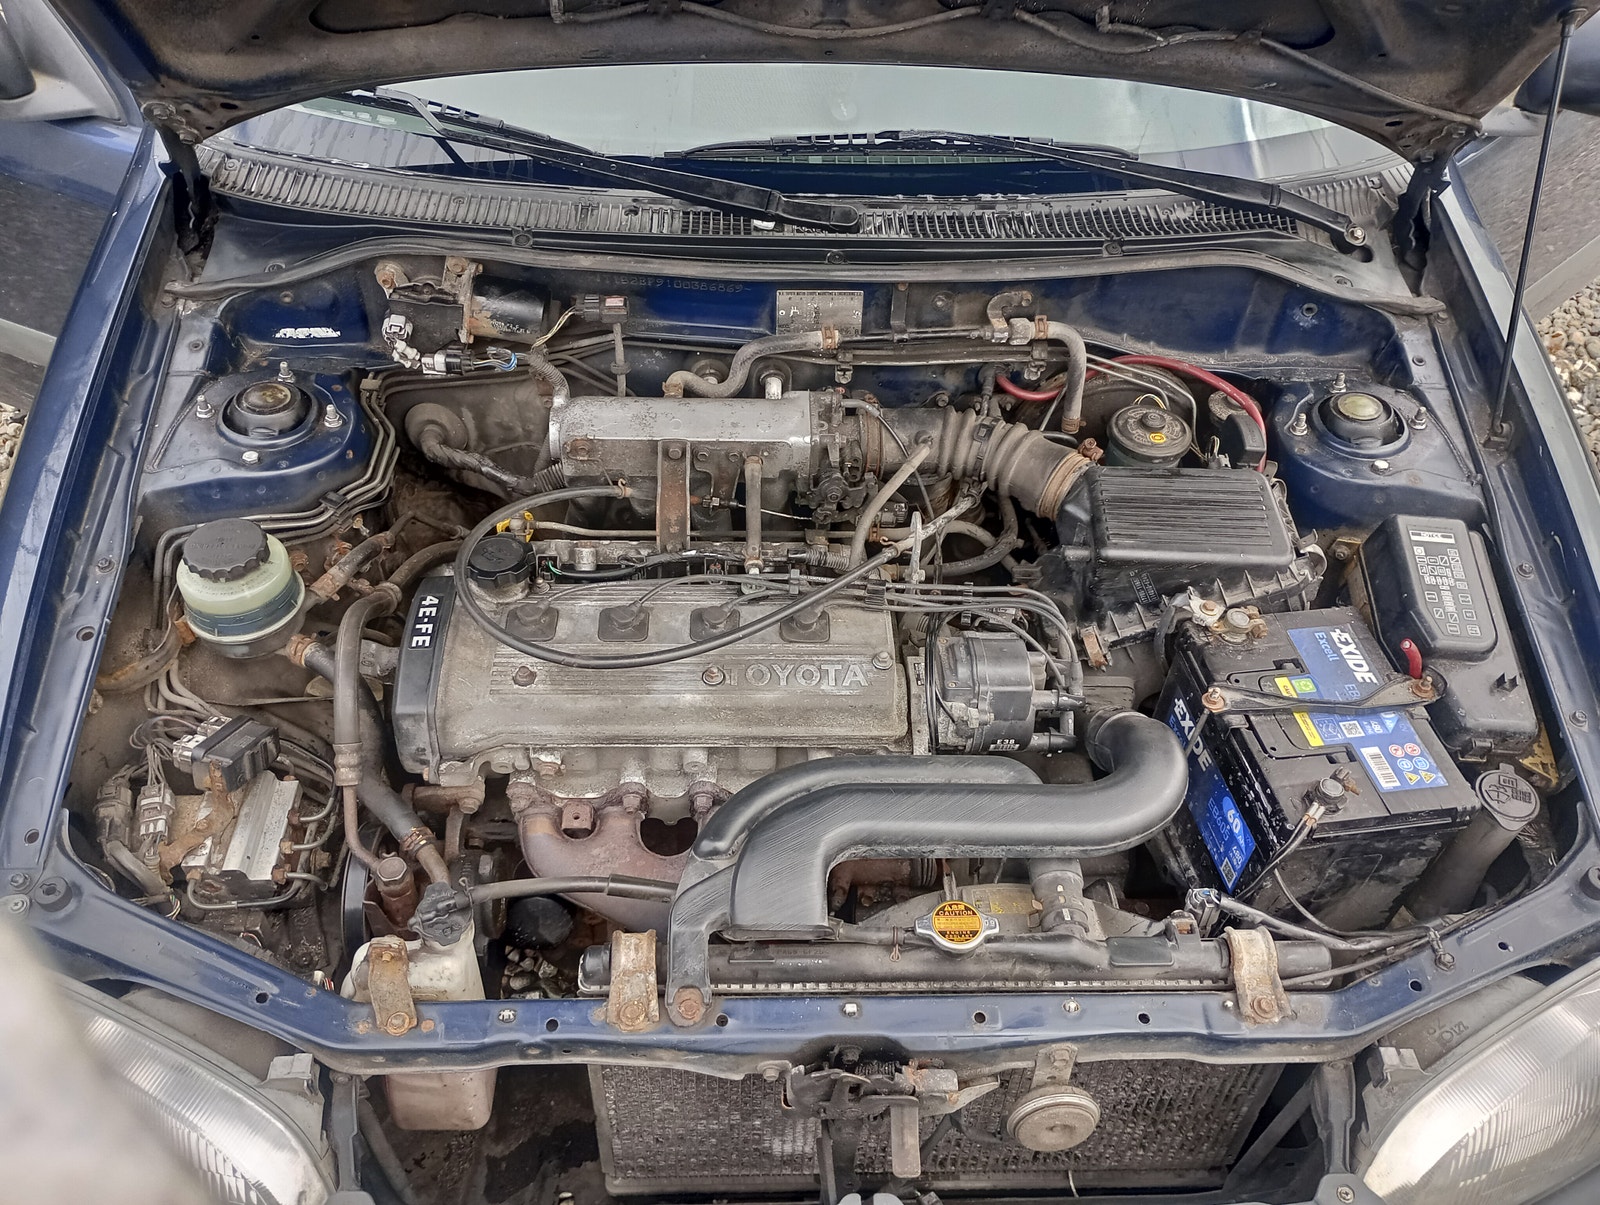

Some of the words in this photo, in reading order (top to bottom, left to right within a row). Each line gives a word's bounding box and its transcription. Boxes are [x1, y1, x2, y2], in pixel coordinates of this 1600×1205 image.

[411, 595, 439, 648] 4E-FE
[1314, 632, 1340, 662] Excell
[1330, 628, 1379, 685] EXIDE
[723, 663, 869, 687] TOYOTA
[1208, 797, 1231, 841] EB605
[1227, 809, 1241, 834] 60
